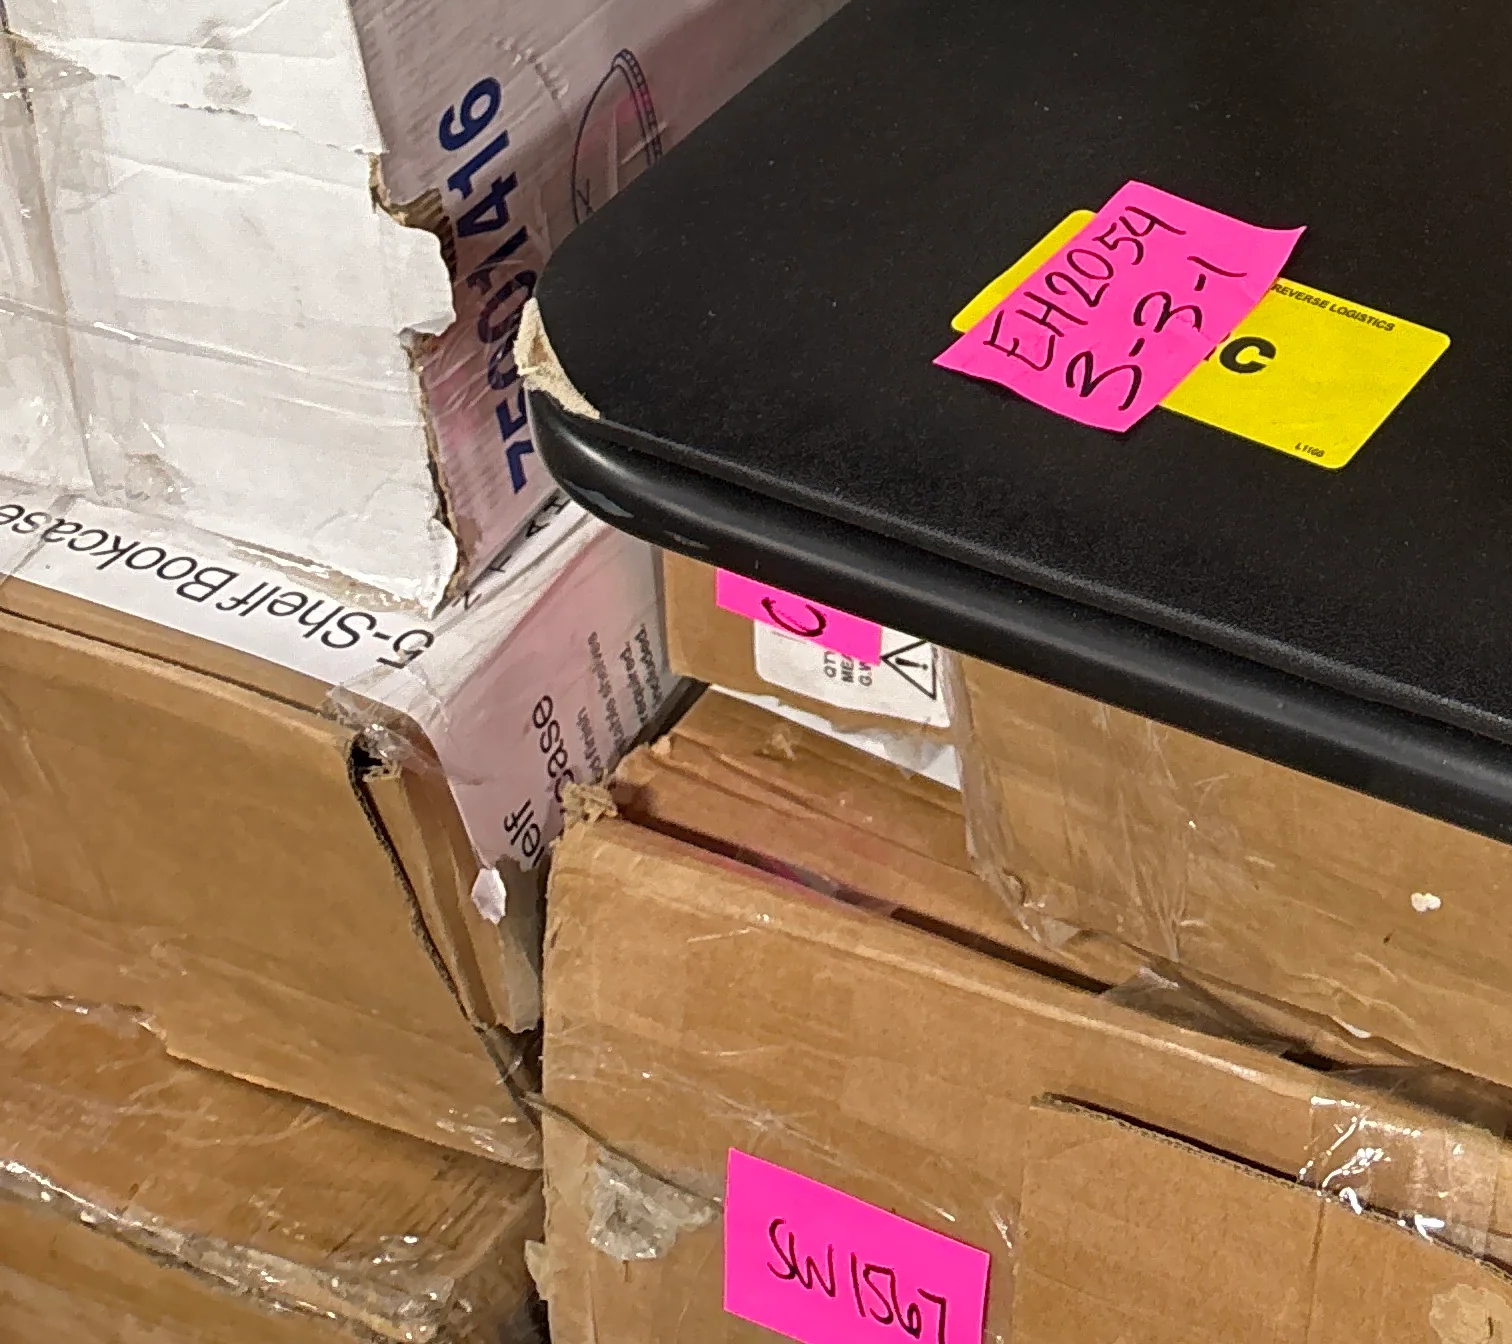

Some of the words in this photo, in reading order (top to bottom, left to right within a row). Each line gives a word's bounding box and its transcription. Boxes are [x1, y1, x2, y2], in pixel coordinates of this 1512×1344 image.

[983, 206, 1186, 371] EH2054
[1066, 256, 1248, 411] 3-3-1
[1271, 282, 1330, 313] REVERSE
[1329, 304, 1396, 332] LOGISTICS
[1204, 334, 1276, 374] C
[0, 504, 238, 602] Bookcase
[217, 581, 434, 669] 5-Shelf
